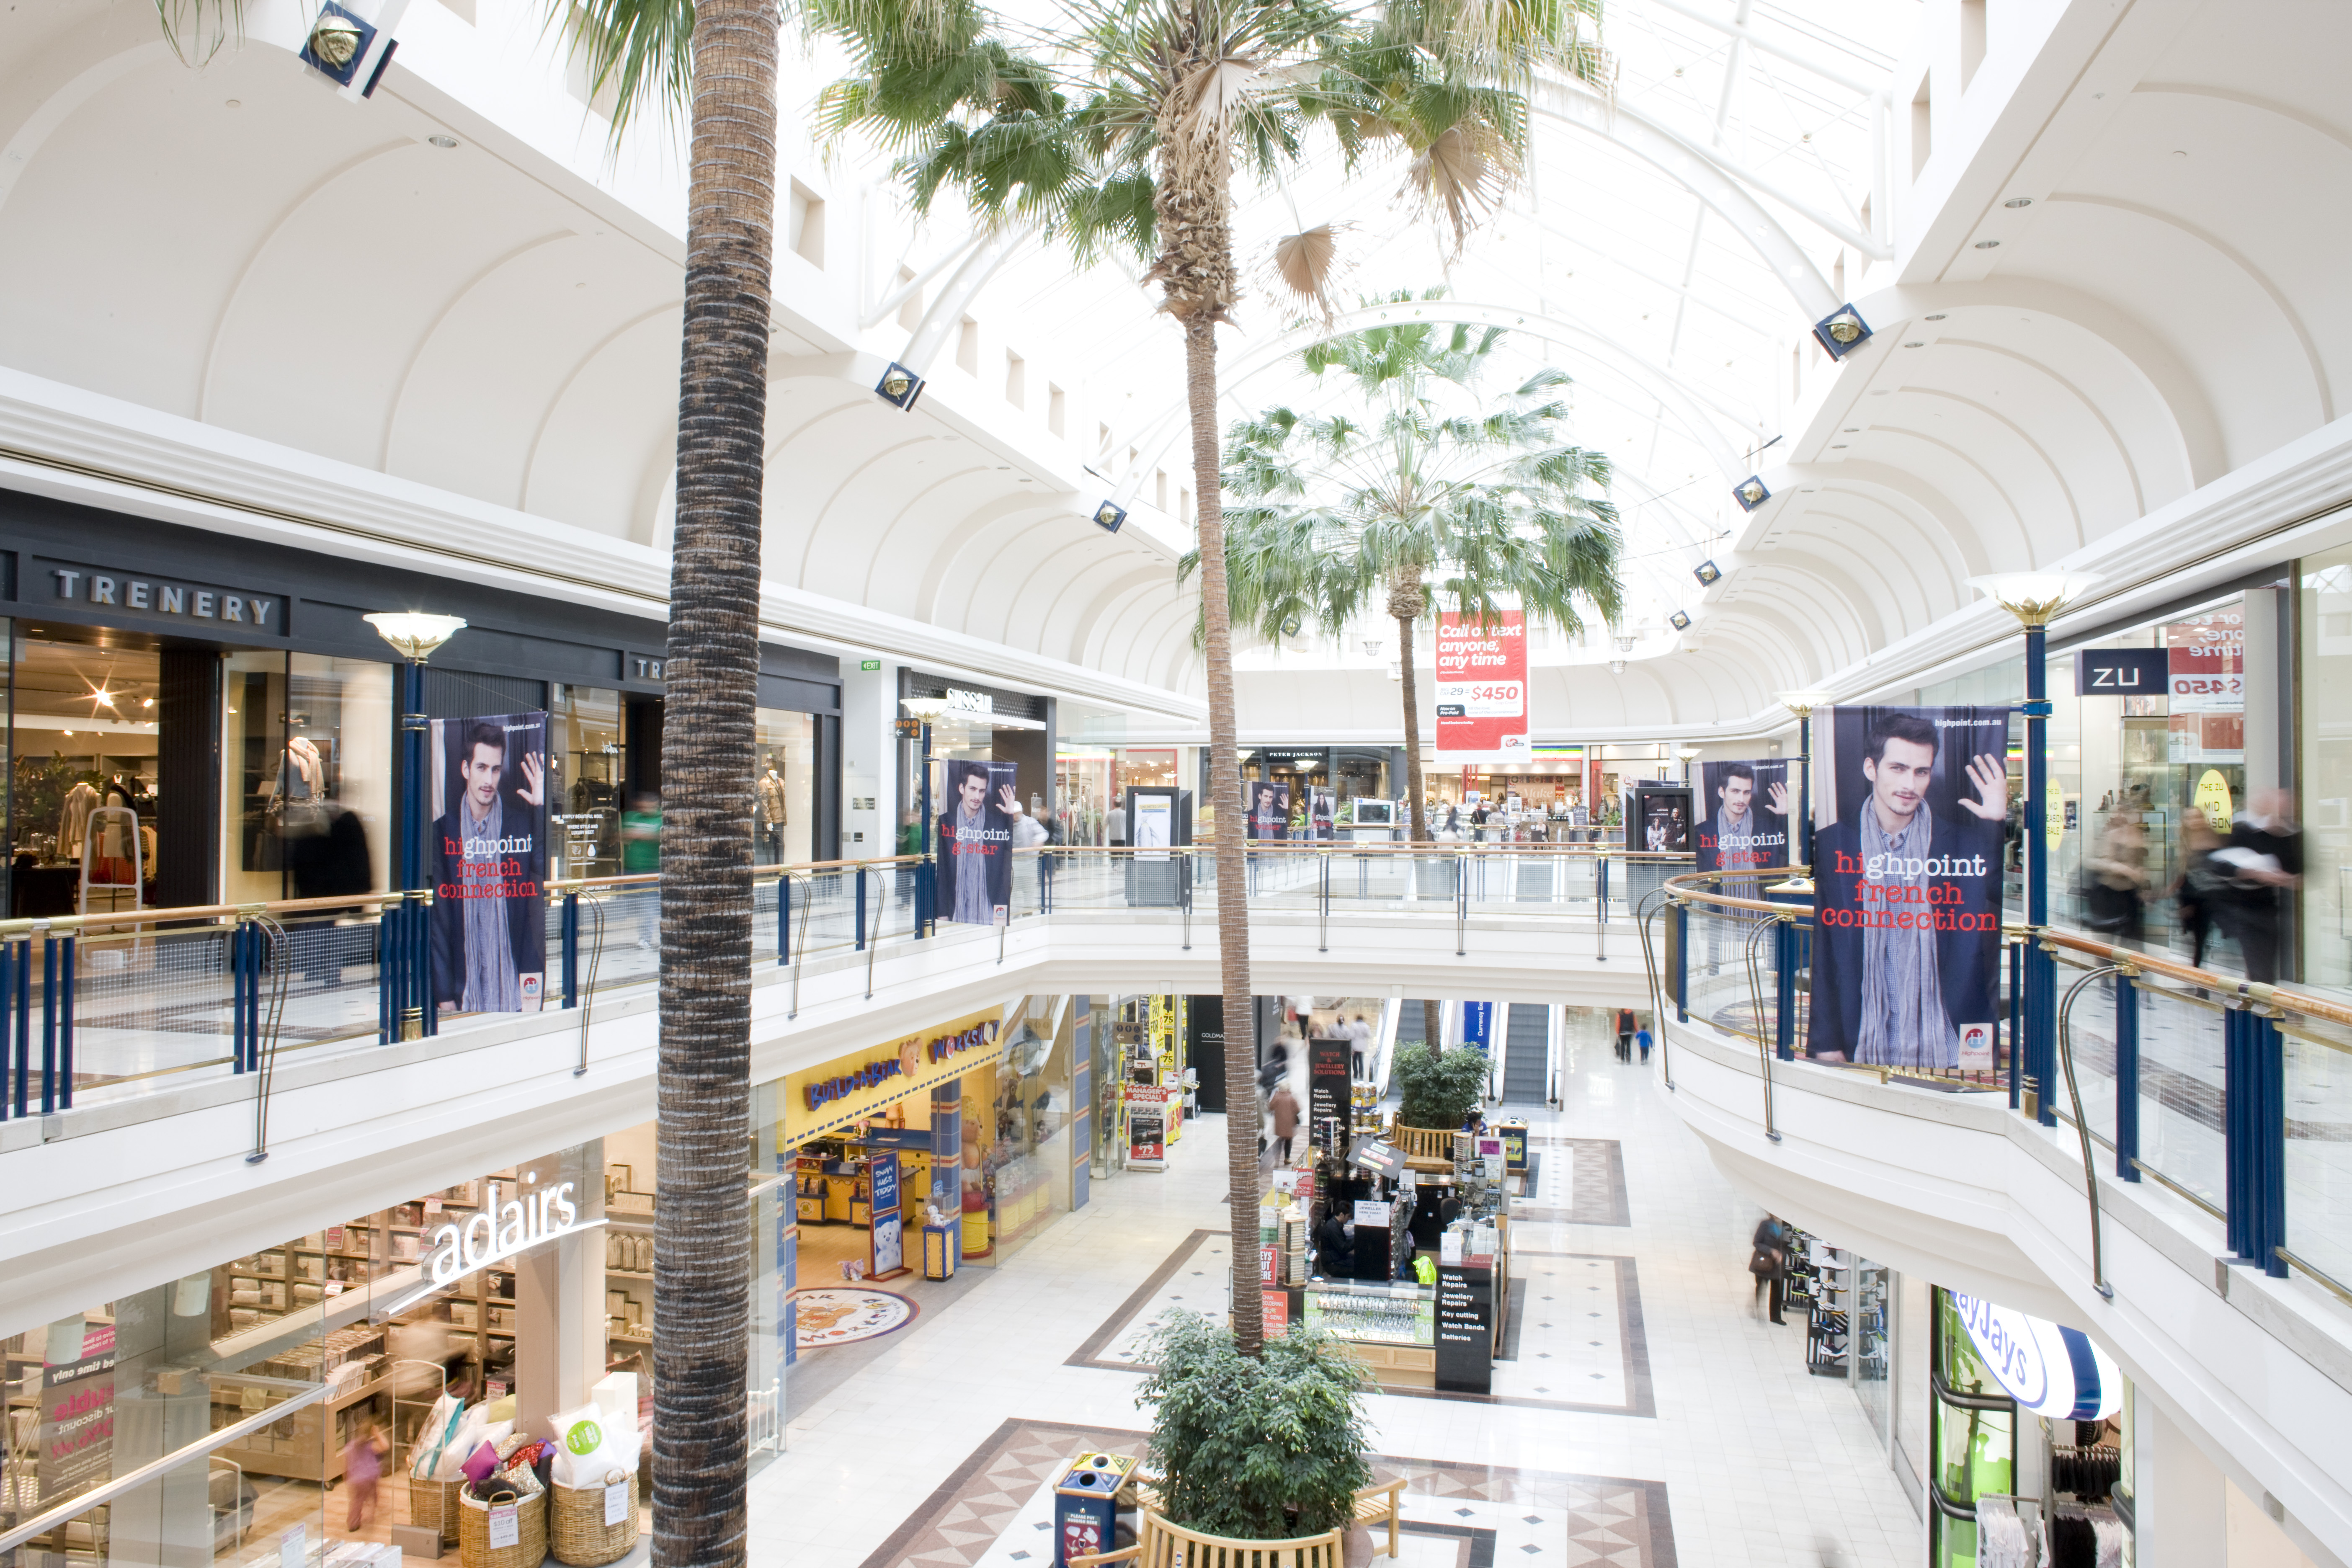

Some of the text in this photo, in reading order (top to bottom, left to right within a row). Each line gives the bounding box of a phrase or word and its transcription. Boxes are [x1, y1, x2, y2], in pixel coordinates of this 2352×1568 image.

[54, 570, 271, 624] TRENERY
[1439, 624, 1470, 638] Call
[867, 661, 879, 670] EXIT
[1439, 652, 1507, 670] any time
[635, 659, 666, 679] TR
[2092, 667, 2139, 687] ZU
[1471, 685, 1519, 701] $450
[946, 687, 993, 714] sussan
[503, 722, 541, 732] highpoint.com.au
[1934, 718, 2001, 728] highpoint.com.au
[2204, 801, 2220, 812] MID
[1250, 815, 1287, 823] highpoint
[2046, 814, 2063, 823] EASON
[2206, 818, 2231, 829] ASON
[941, 824, 1010, 842] highpoint
[2046, 826, 2060, 835] SALE
[444, 833, 532, 859] highpoint
[1700, 831, 1785, 850] highpoint
[952, 842, 998, 855] g-star
[1716, 850, 1772, 867] g-star
[1834, 850, 1987, 881] highpoint
[456, 857, 522, 878] french
[438, 879, 538, 899] connection
[1854, 879, 1965, 905] french
[1821, 907, 1998, 931] connection
[1150, 1019, 1159, 1034] FOR
[1160, 1016, 1163, 1030] 2
[927, 1019, 1000, 1065] WORKSHOP
[1138, 1144, 1154, 1154] $79
[875, 1165, 893, 1177] SNOW
[877, 1175, 892, 1187] HUGS
[874, 1184, 897, 1197] TEDDY
[429, 1171, 576, 1284] adairs
[1260, 1251, 1272, 1261] EYS
[1261, 1261, 1271, 1270] UT
[1442, 1292, 1473, 1301] Jewellery
[1455, 1312, 1479, 1320] cutting
[1379, 1333, 1416, 1343] REPAIRS
[1416, 1322, 1433, 1340] $30
[1441, 1333, 1471, 1341] Batteries
[1957, 1290, 2027, 1386] ayJays
[609, 1493, 624, 1501] VALUE
